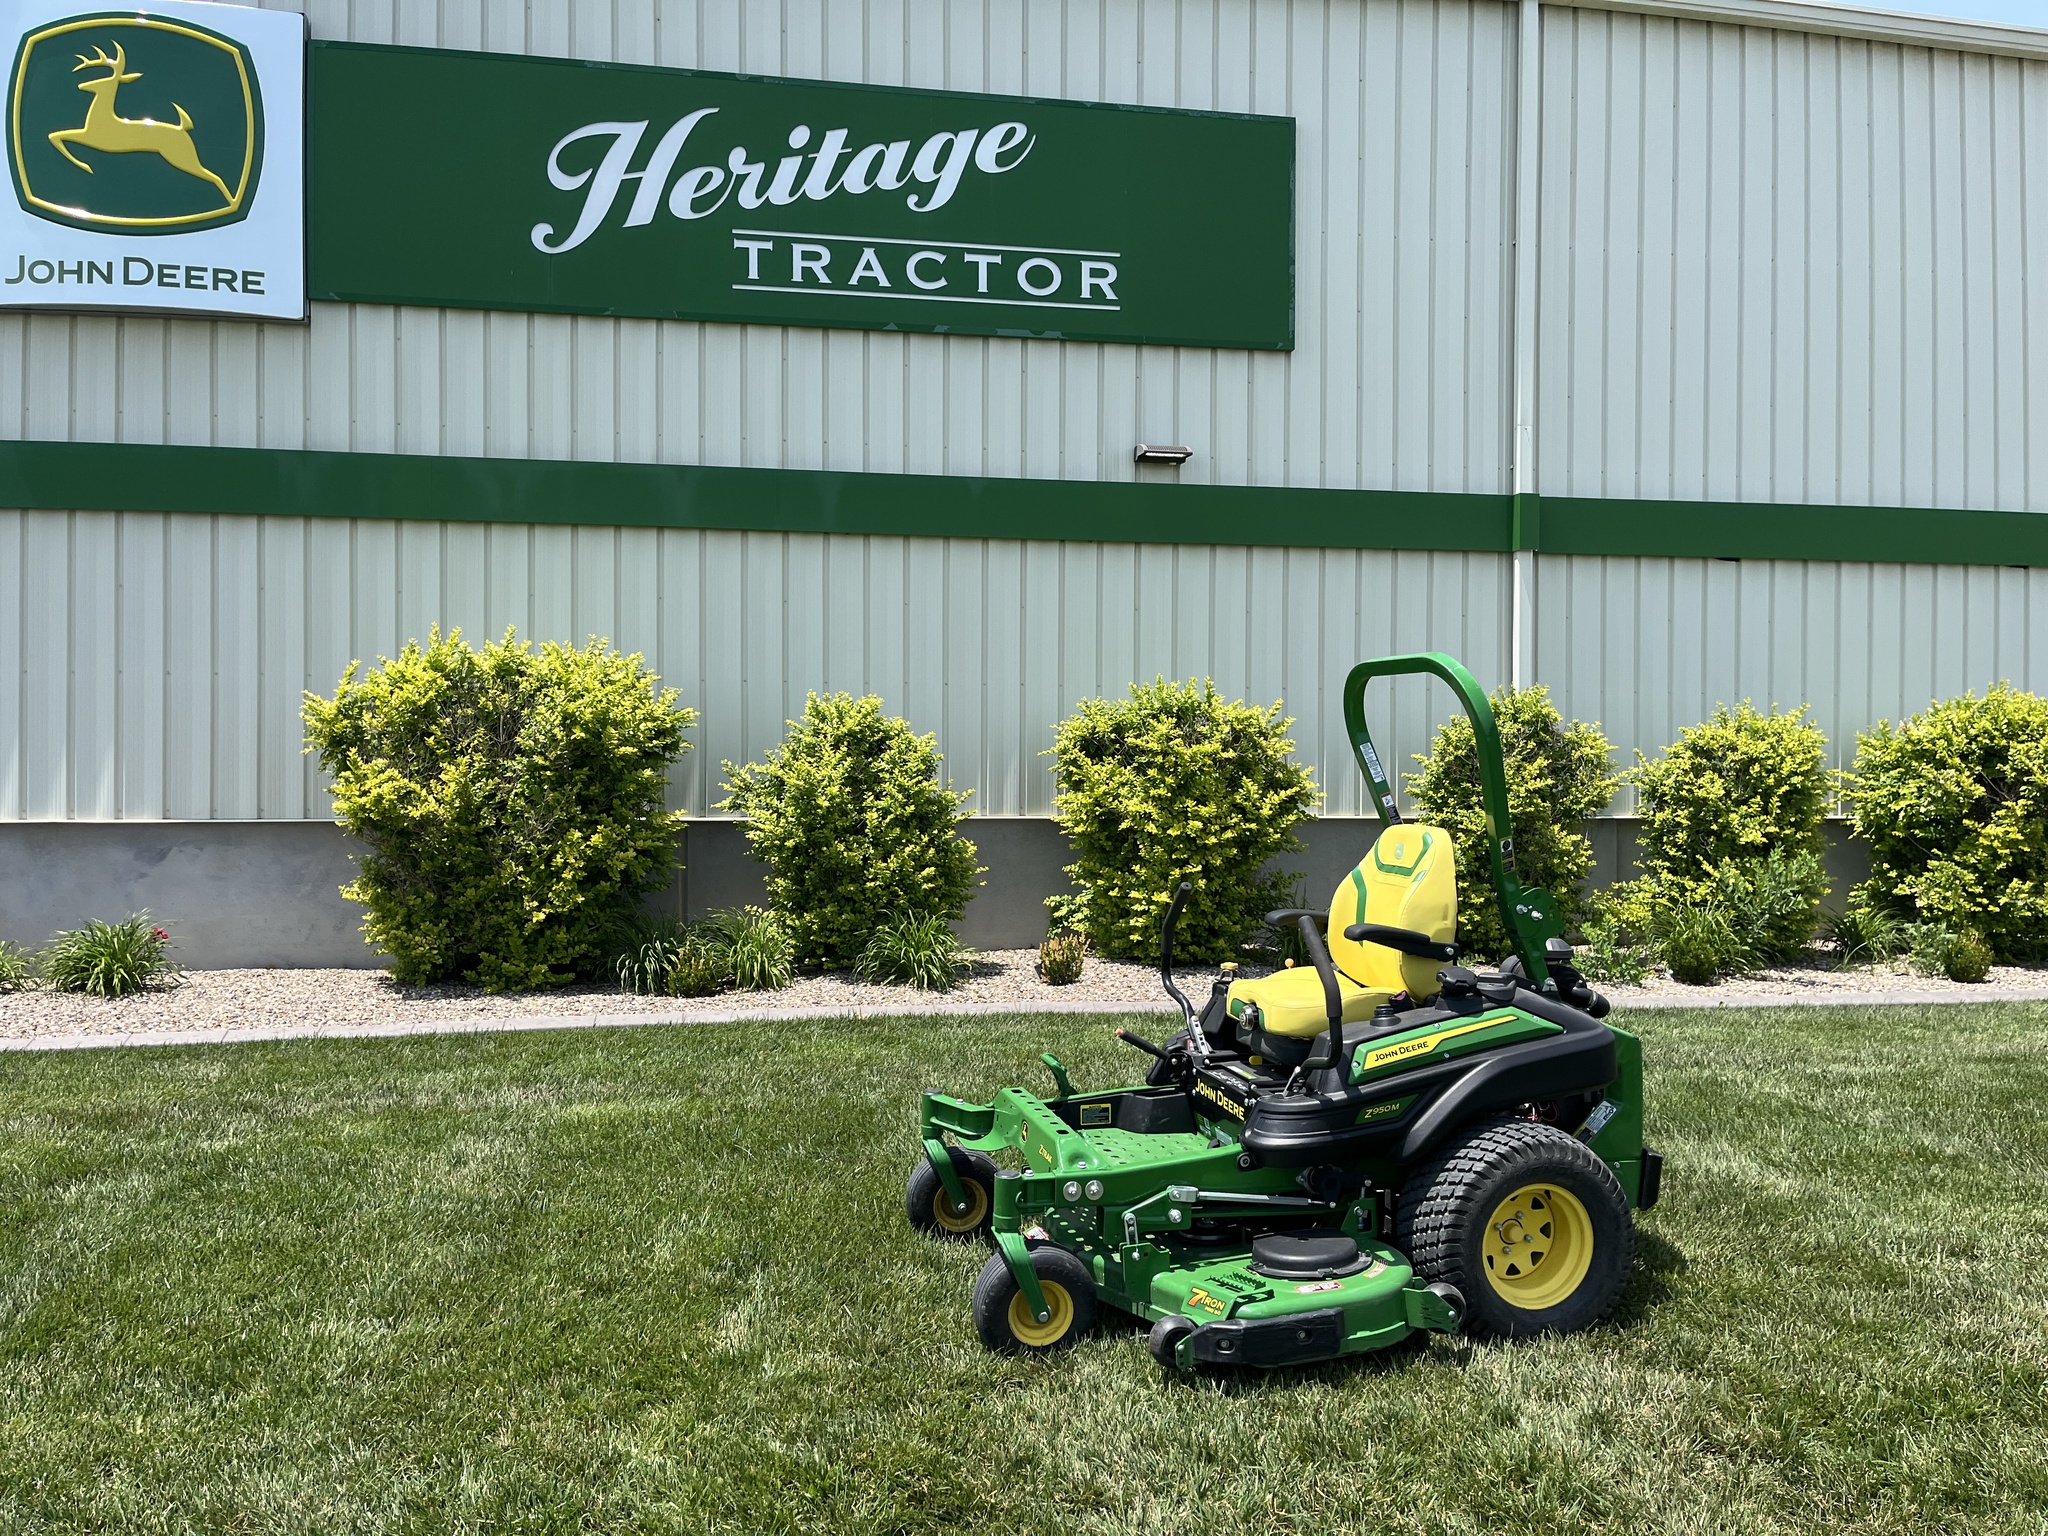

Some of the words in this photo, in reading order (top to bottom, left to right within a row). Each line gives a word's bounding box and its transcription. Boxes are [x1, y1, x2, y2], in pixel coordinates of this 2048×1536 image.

[530, 107, 1036, 254] Heritage
[5, 255, 113, 285] JOHN
[122, 256, 265, 295] DEERE
[732, 237, 1120, 300] TRACTOR
[1374, 1050, 1398, 1062] JOHN
[1398, 1041, 1429, 1055] DEERE
[1195, 1078, 1216, 1103] JOHN
[1217, 1090, 1245, 1121] DEERE
[1364, 1103, 1400, 1118] Z950M
